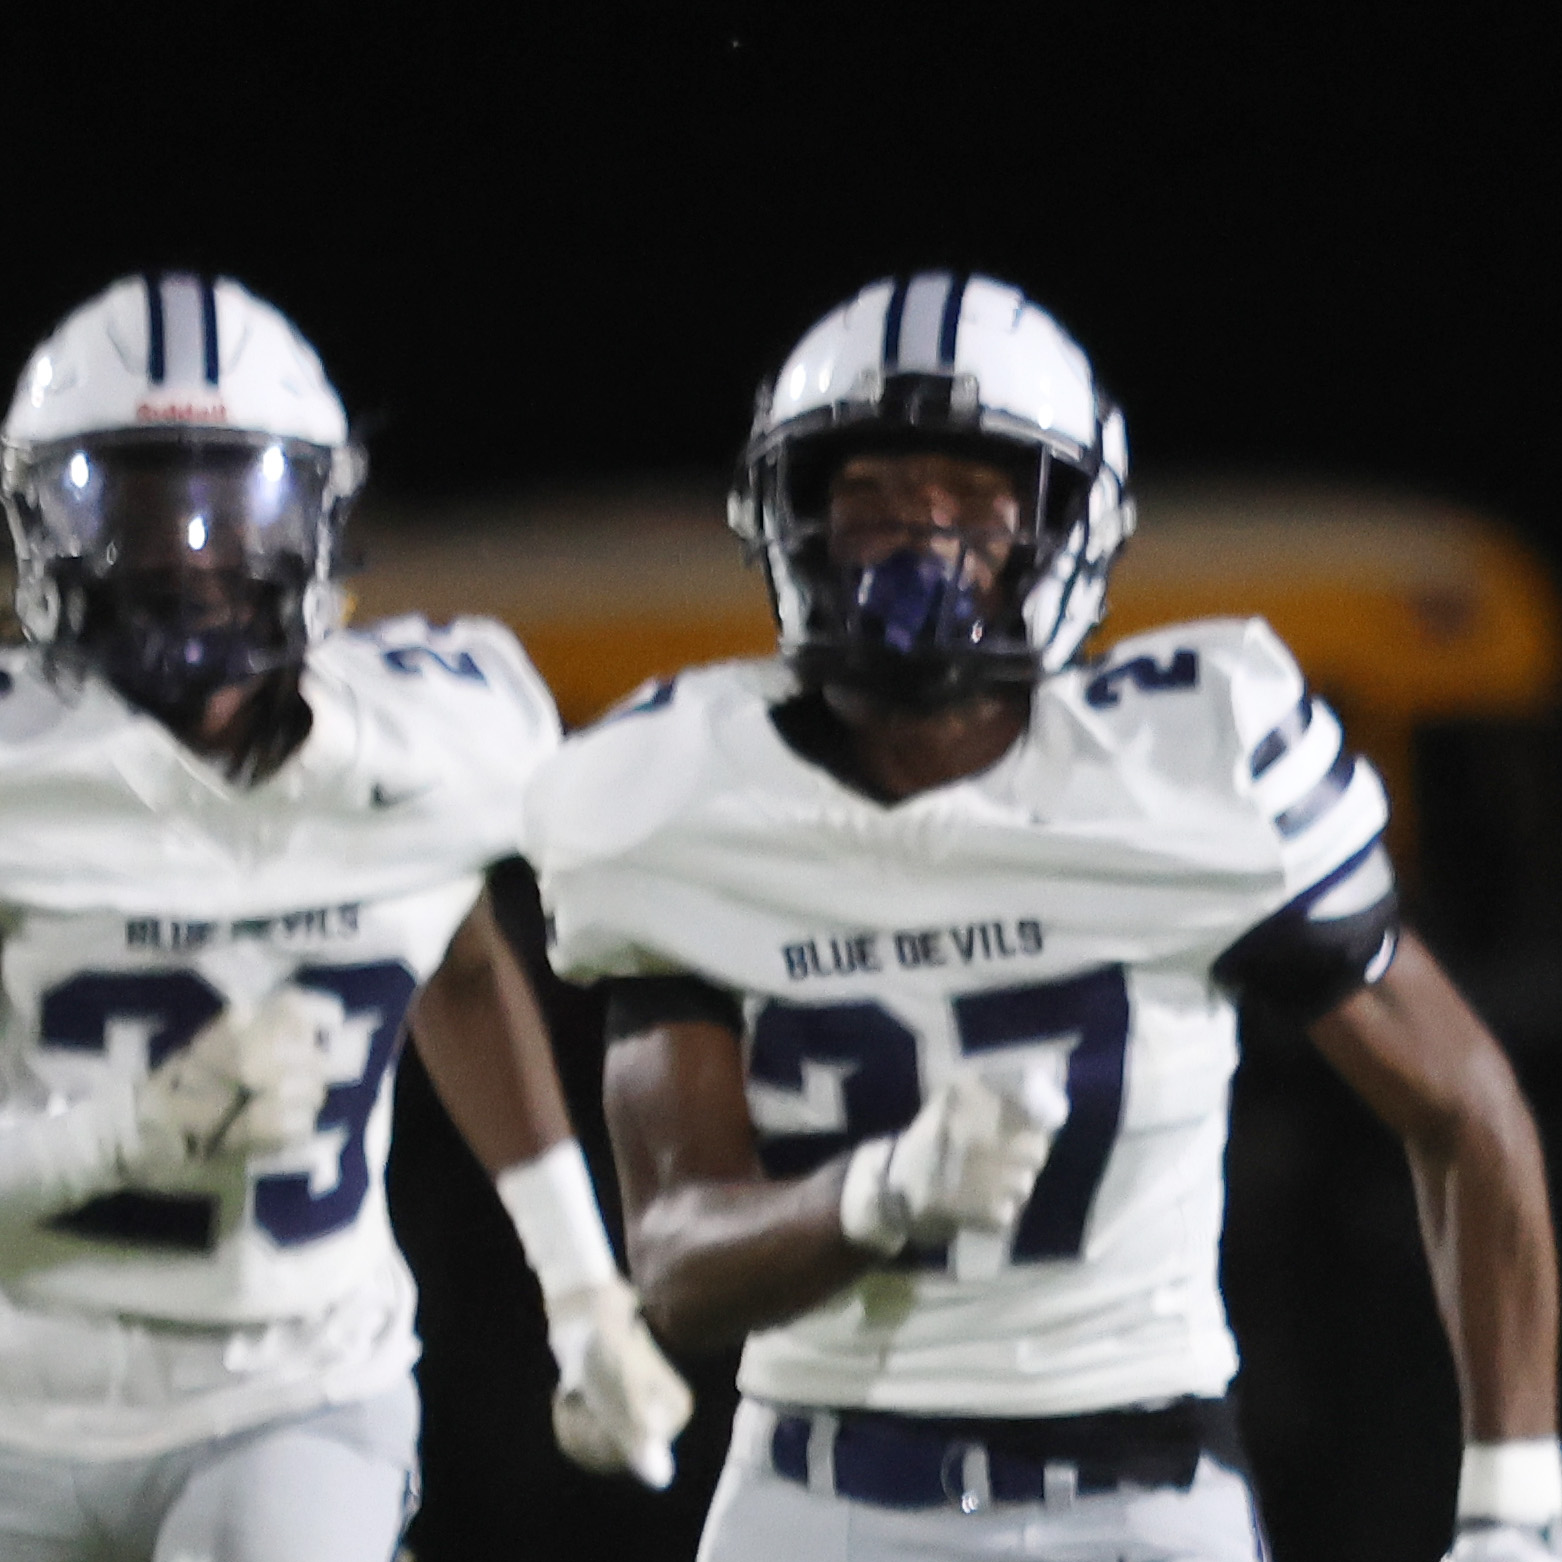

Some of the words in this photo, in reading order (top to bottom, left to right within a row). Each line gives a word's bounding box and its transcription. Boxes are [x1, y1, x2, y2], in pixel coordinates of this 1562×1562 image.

[781, 933, 882, 982] BLUE
[893, 918, 1043, 971] DEVILS
[748, 960, 1129, 1275] 27
